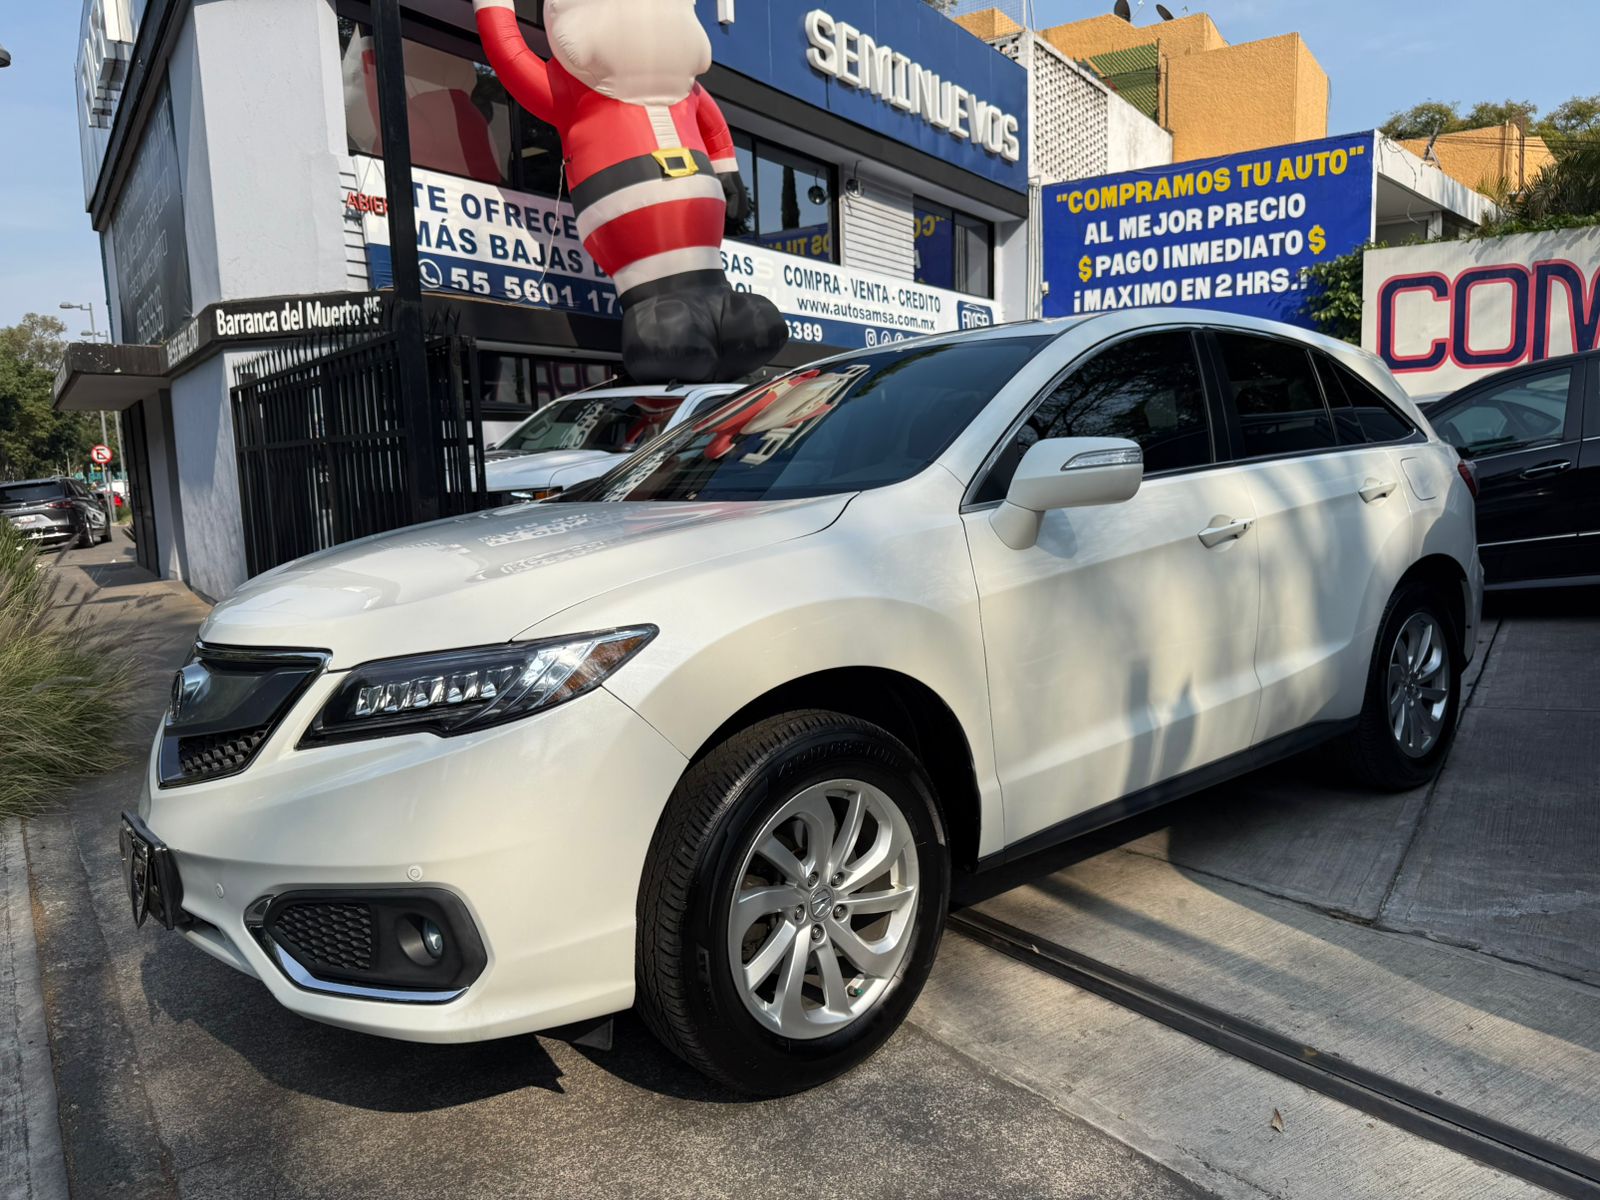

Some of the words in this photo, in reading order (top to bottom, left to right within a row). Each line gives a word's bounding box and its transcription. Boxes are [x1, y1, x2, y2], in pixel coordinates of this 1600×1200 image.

[805, 9, 1019, 162] SEMINUEVOS
[1056, 167, 1231, 214] "COMPRAMOS
[1237, 161, 1272, 187] TU
[1276, 145, 1365, 183] AUTO"
[411, 181, 449, 214] TE
[460, 193, 580, 241] OFRECE
[1084, 222, 1114, 246] AL
[1119, 204, 1203, 241] MEJOR
[1207, 193, 1306, 229] PRECIO
[489, 234, 584, 274] BAJAS
[1095, 247, 1158, 278] PAGO
[1163, 230, 1303, 269] INMEDIATO
[450, 266, 491, 295] 55
[504, 275, 575, 308] 5601
[587, 289, 623, 315] 17
[784, 264, 841, 296] COMPRA
[850, 277, 889, 304] VENTA
[898, 288, 941, 313] CREDITO
[1181, 277, 1211, 302] EN
[1215, 273, 1233, 298] 2
[215, 308, 279, 336] Barranca
[280, 300, 303, 331] del
[306, 300, 361, 330] Muerto
[797, 297, 936, 331] www.autosamsa.com.mx
